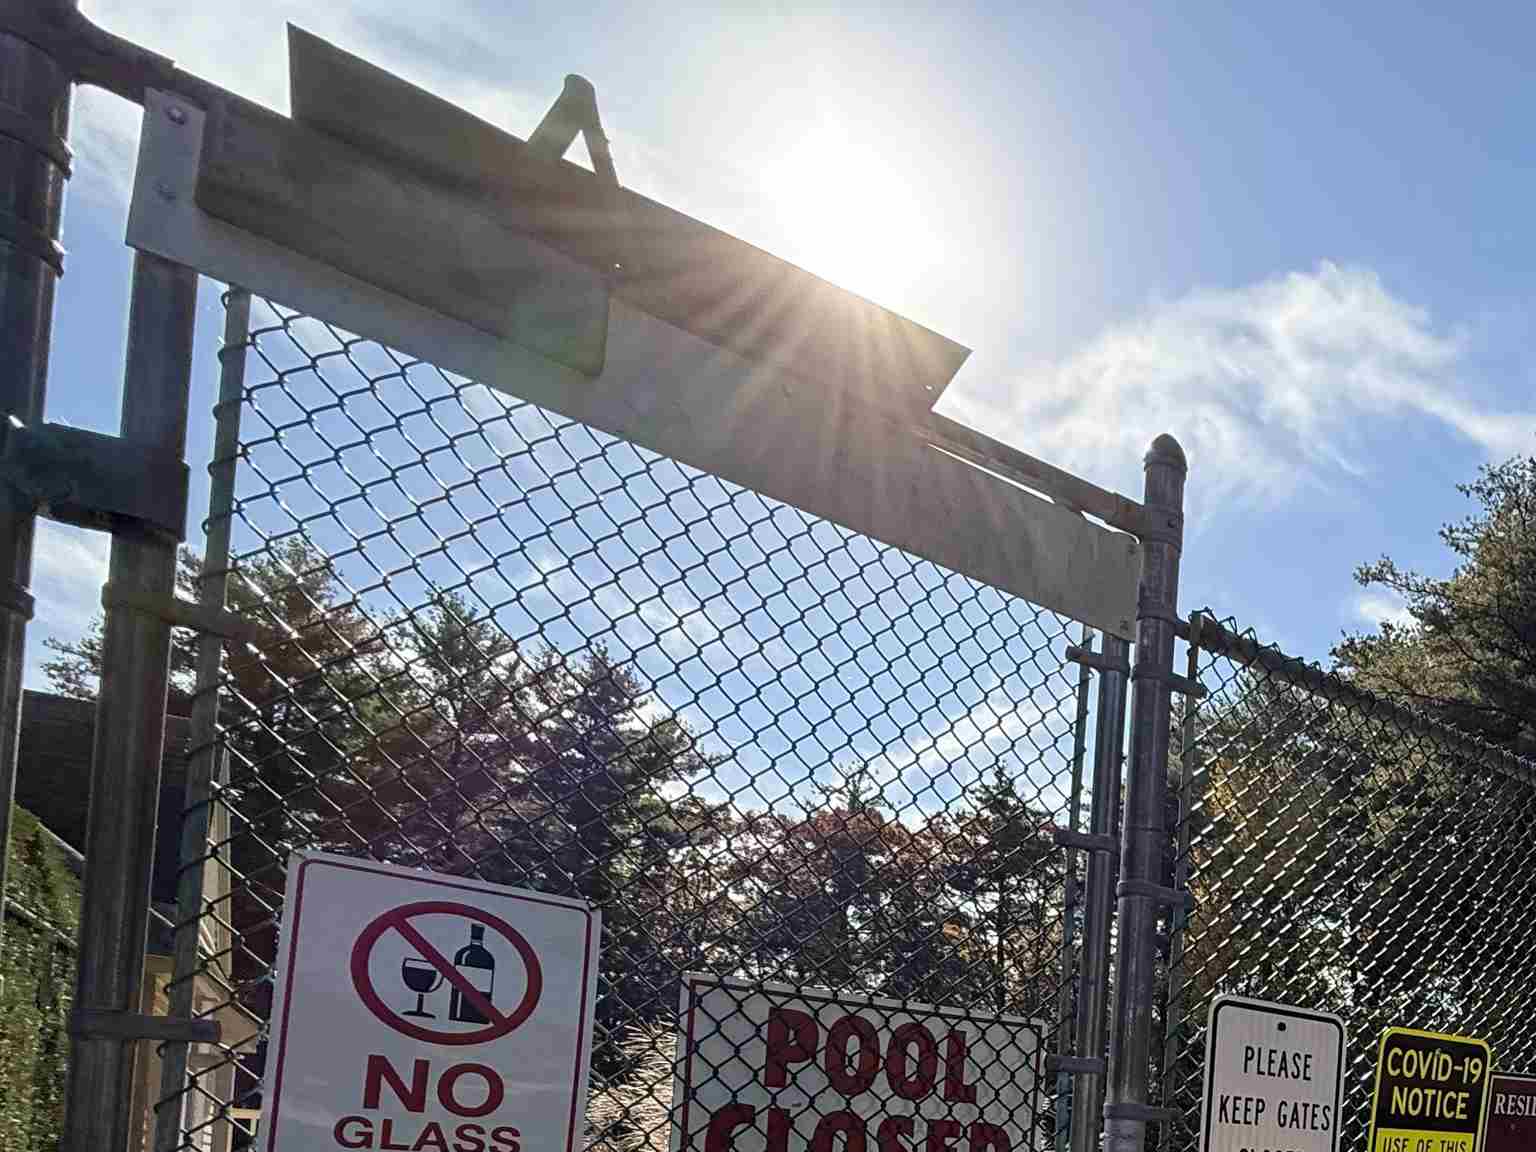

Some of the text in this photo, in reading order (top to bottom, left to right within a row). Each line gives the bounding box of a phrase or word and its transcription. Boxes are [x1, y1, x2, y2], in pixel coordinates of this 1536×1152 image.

[764, 1007, 976, 1104] POOL
[1243, 1046, 1312, 1081] PLEASE
[1387, 1048, 1483, 1084] COVID-19
[363, 1055, 504, 1118] NO
[1391, 1085, 1470, 1120] NOTICE
[1219, 1095, 1331, 1131] KEEP GATES
